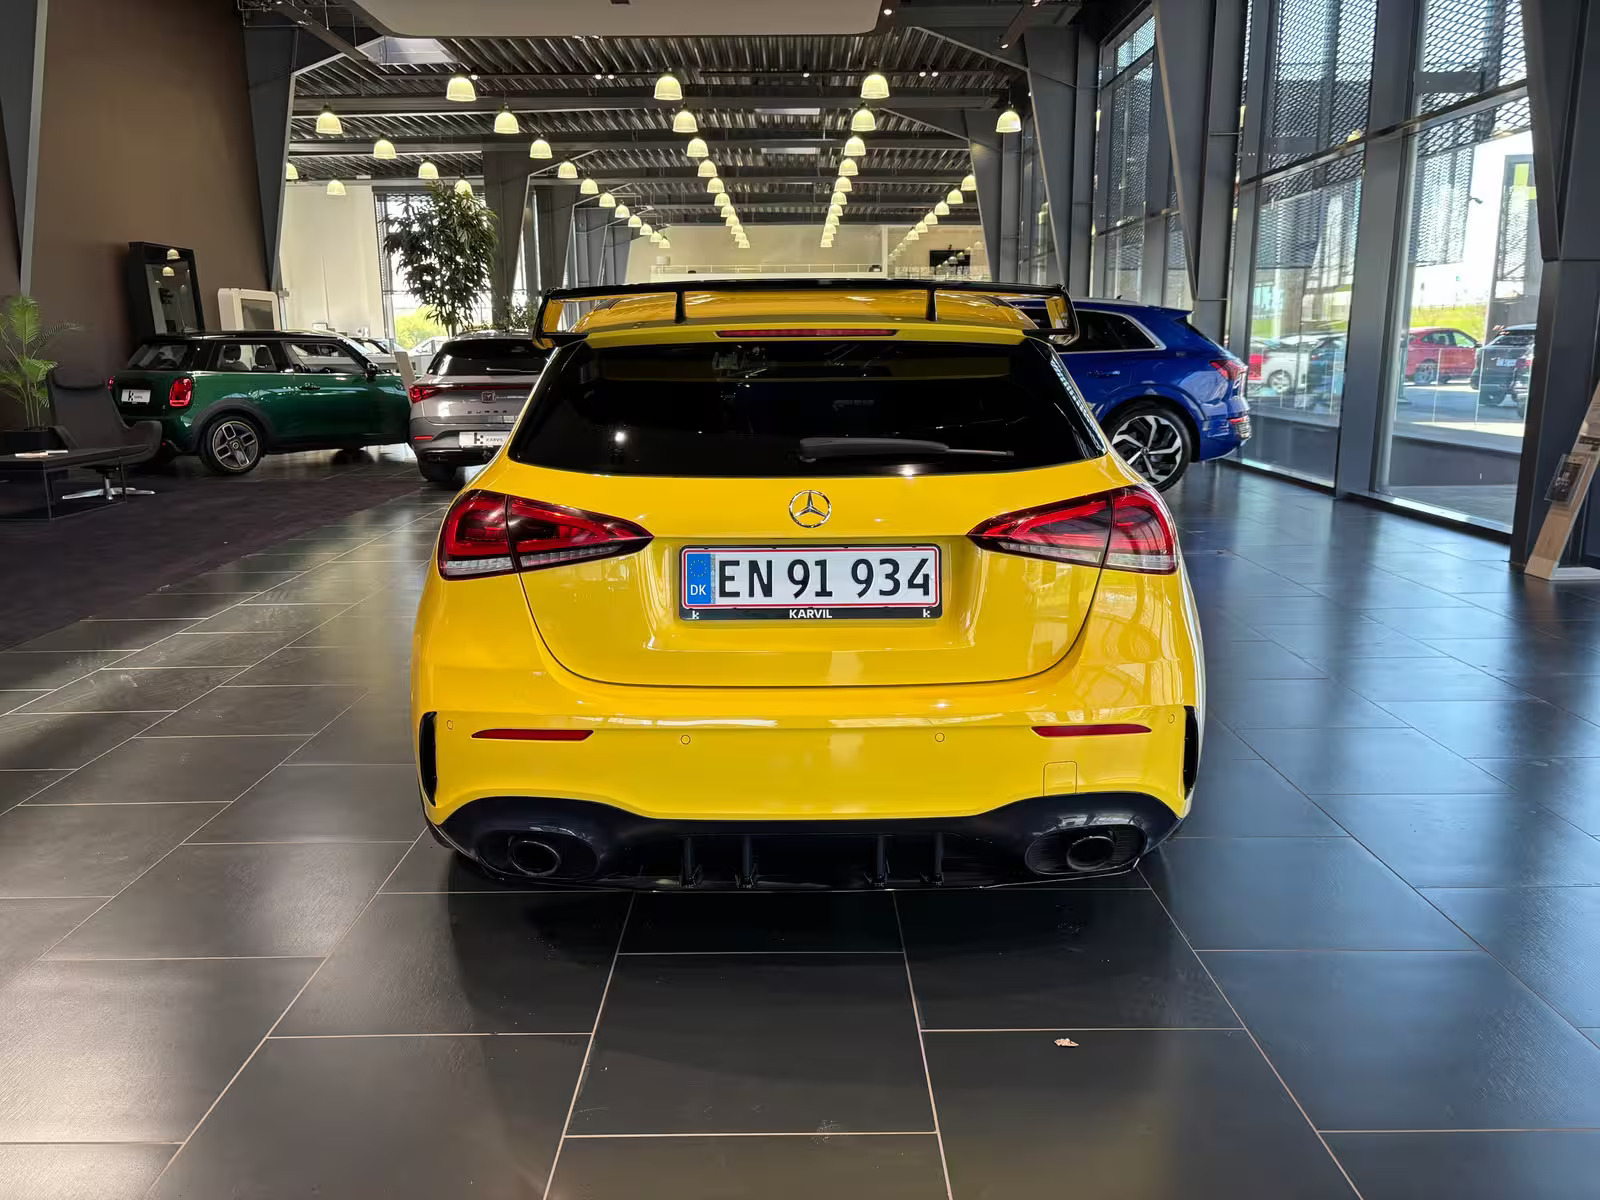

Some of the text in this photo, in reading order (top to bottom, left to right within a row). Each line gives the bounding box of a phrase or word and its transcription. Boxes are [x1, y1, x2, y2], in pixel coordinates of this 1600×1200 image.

[718, 557, 930, 599] EN 91 934
[690, 584, 707, 596] DK
[789, 609, 833, 619] KARVIL
